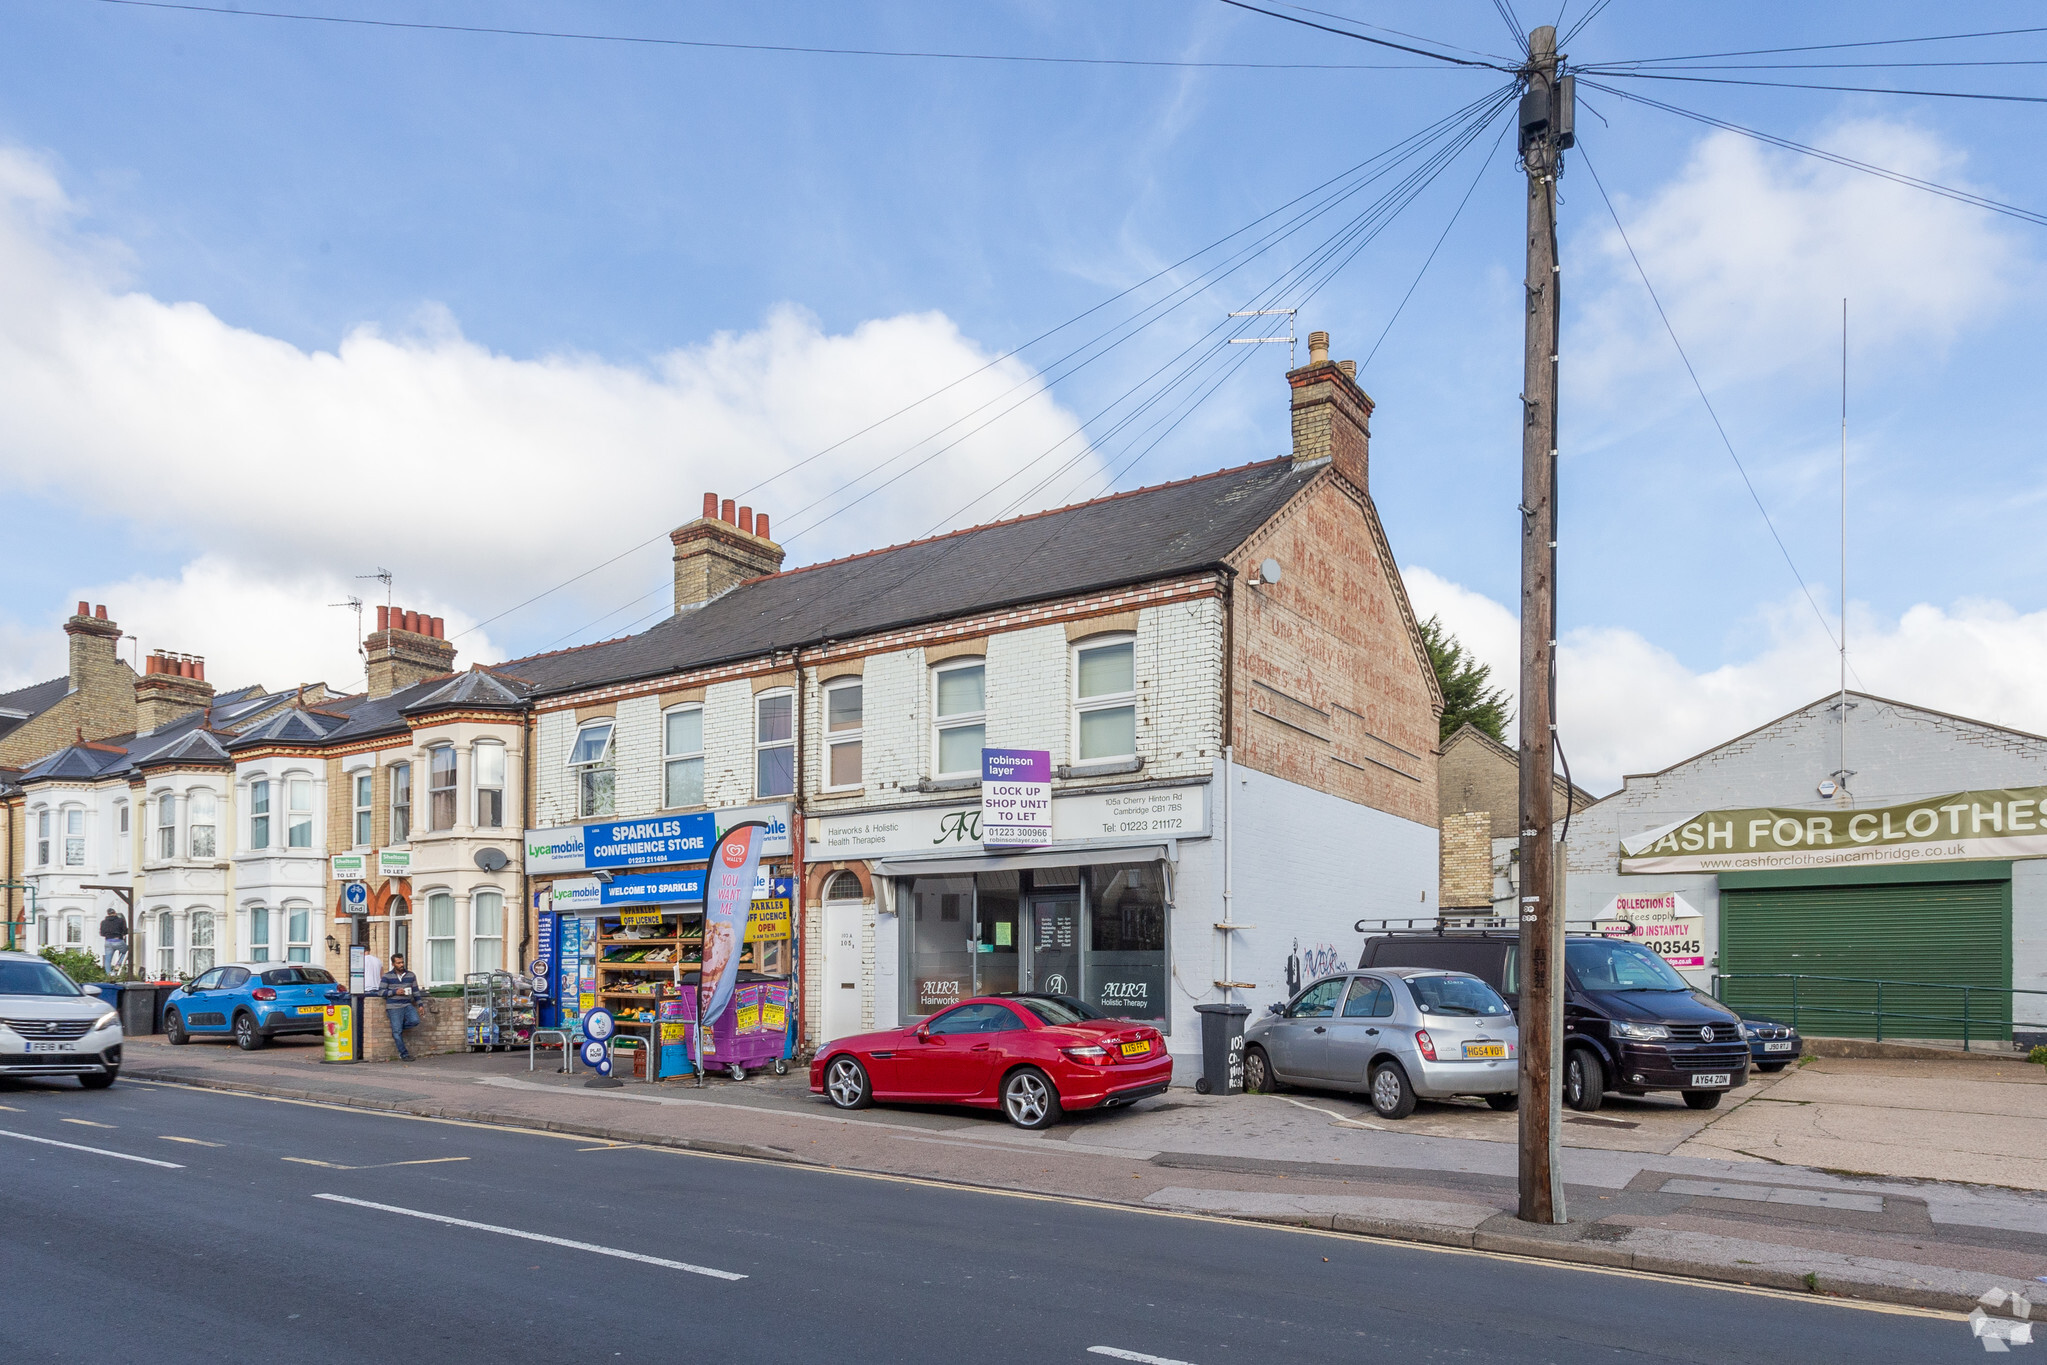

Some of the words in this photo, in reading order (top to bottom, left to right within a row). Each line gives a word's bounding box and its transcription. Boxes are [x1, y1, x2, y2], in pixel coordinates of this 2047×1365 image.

[989, 756, 1033, 765] robinson
[989, 765, 1014, 776] layer
[993, 786, 1022, 795] LOCK
[1026, 787, 1040, 796] UP
[985, 799, 1016, 808] SHOP
[1020, 800, 1048, 809] UNIT
[1123, 797, 1146, 805] Cherry
[1148, 794, 1170, 802] Hinton
[1113, 807, 1149, 815] Cambridge
[1151, 805, 1165, 813] CB1
[1168, 803, 1183, 811] 7BS
[998, 811, 1014, 820] TO
[1017, 812, 1036, 820] LET
[828, 826, 862, 836] Hairworks
[872, 823, 899, 833] Holistic
[933, 810, 983, 844] AU
[1103, 823, 1117, 832] Tel:
[1120, 821, 1148, 832] 01223
[1152, 818, 1182, 830] 211172
[612, 821, 681, 841] SPARKLES
[989, 828, 1014, 836] 01223
[1017, 829, 1047, 837] 300966
[1635, 821, 1734, 855] ASH
[1749, 817, 1834, 847] FOR
[828, 836, 850, 846] Health
[852, 835, 886, 846] Therapies
[529, 839, 584, 858] Lycamobile
[594, 840, 666, 858] CONVENIENCE
[668, 837, 704, 851] STORE
[1699, 843, 1966, 868] www.cashforclothesincambridge.co.uk
[722, 874, 739, 887] YOU
[554, 886, 599, 901] Lycamobile
[609, 884, 646, 896] WELCOME
[647, 885, 657, 894] TO
[658, 882, 698, 894] SPARKLES
[718, 889, 741, 901] WANT
[720, 903, 732, 915] ME
[749, 901, 783, 910] PARKLES
[1617, 898, 1664, 909] COLLECTION
[624, 906, 656, 914] SPARKLES
[624, 916, 635, 925] OFF
[636, 915, 660, 924] LICENCE
[759, 911, 787, 921] LICENCE
[1632, 913, 1650, 921] fees
[758, 923, 776, 932] OPEN
[1646, 924, 1689, 937] INSTANTLY
[921, 981, 960, 994] AURA
[1051, 977, 1063, 994] A
[1101, 982, 1148, 997] AURA
[921, 996, 960, 1005] Hairworks
[1124, 999, 1148, 1008] Therapy
[1231, 1035, 1243, 1050] 103
[1468, 1046, 1488, 1056] HG54
[1695, 1076, 1713, 1084] AY64
